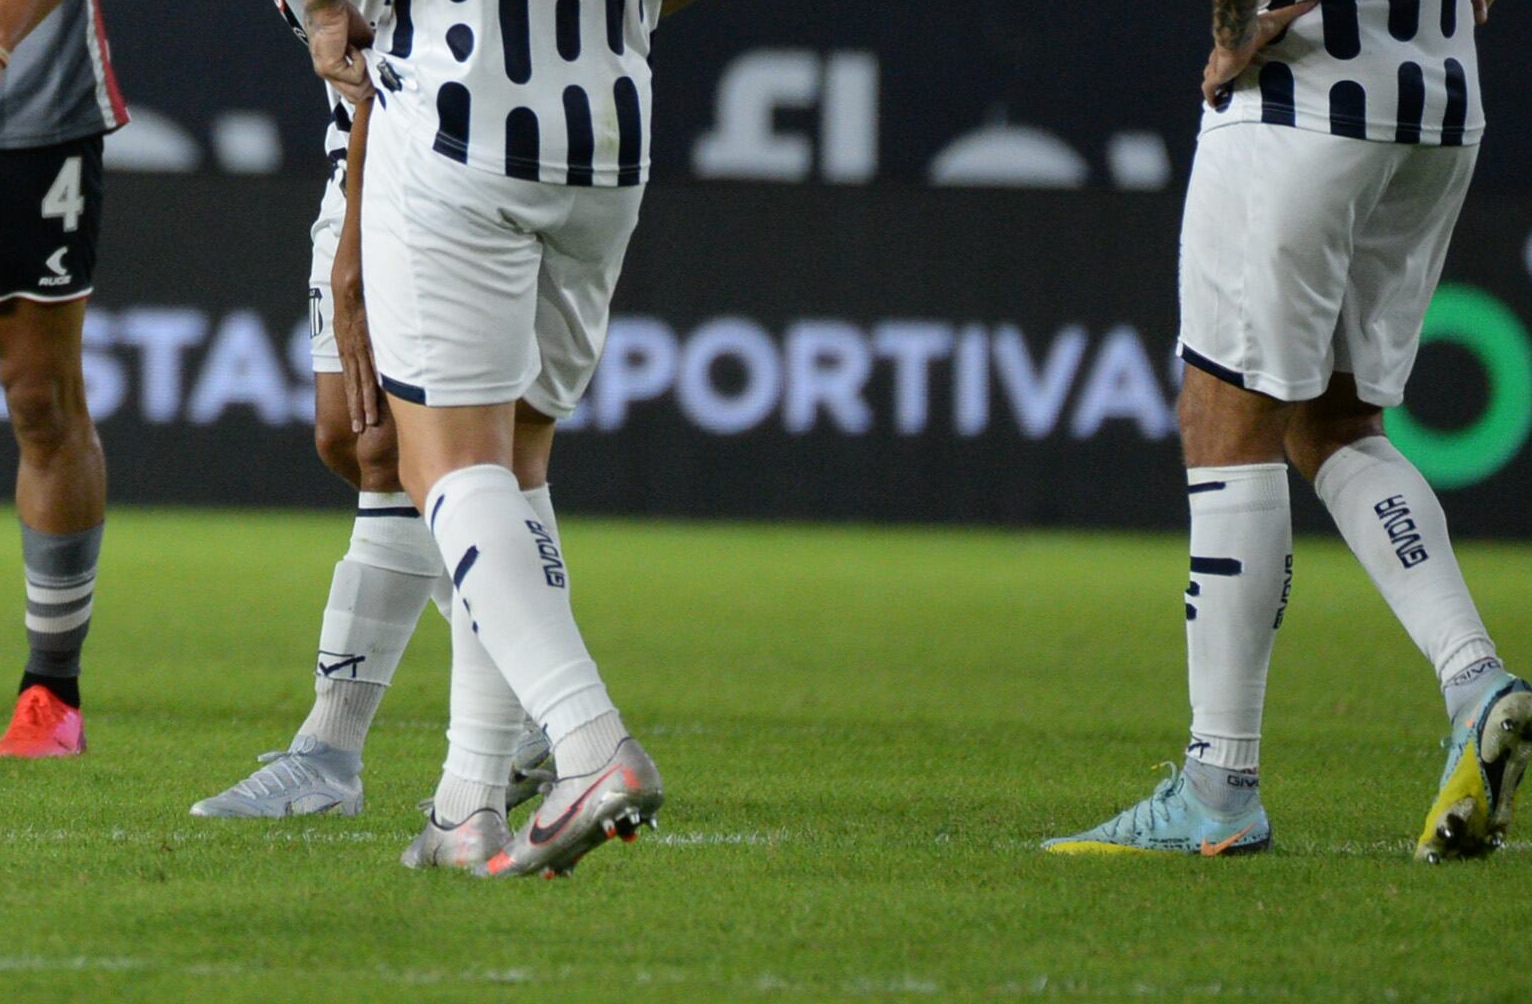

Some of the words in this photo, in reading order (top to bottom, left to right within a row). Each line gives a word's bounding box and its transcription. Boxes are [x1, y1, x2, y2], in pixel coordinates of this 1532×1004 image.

[40, 155, 86, 233] 4
[524, 519, 566, 589] GIVOVA
[1373, 494, 1429, 569] GIVOVA
